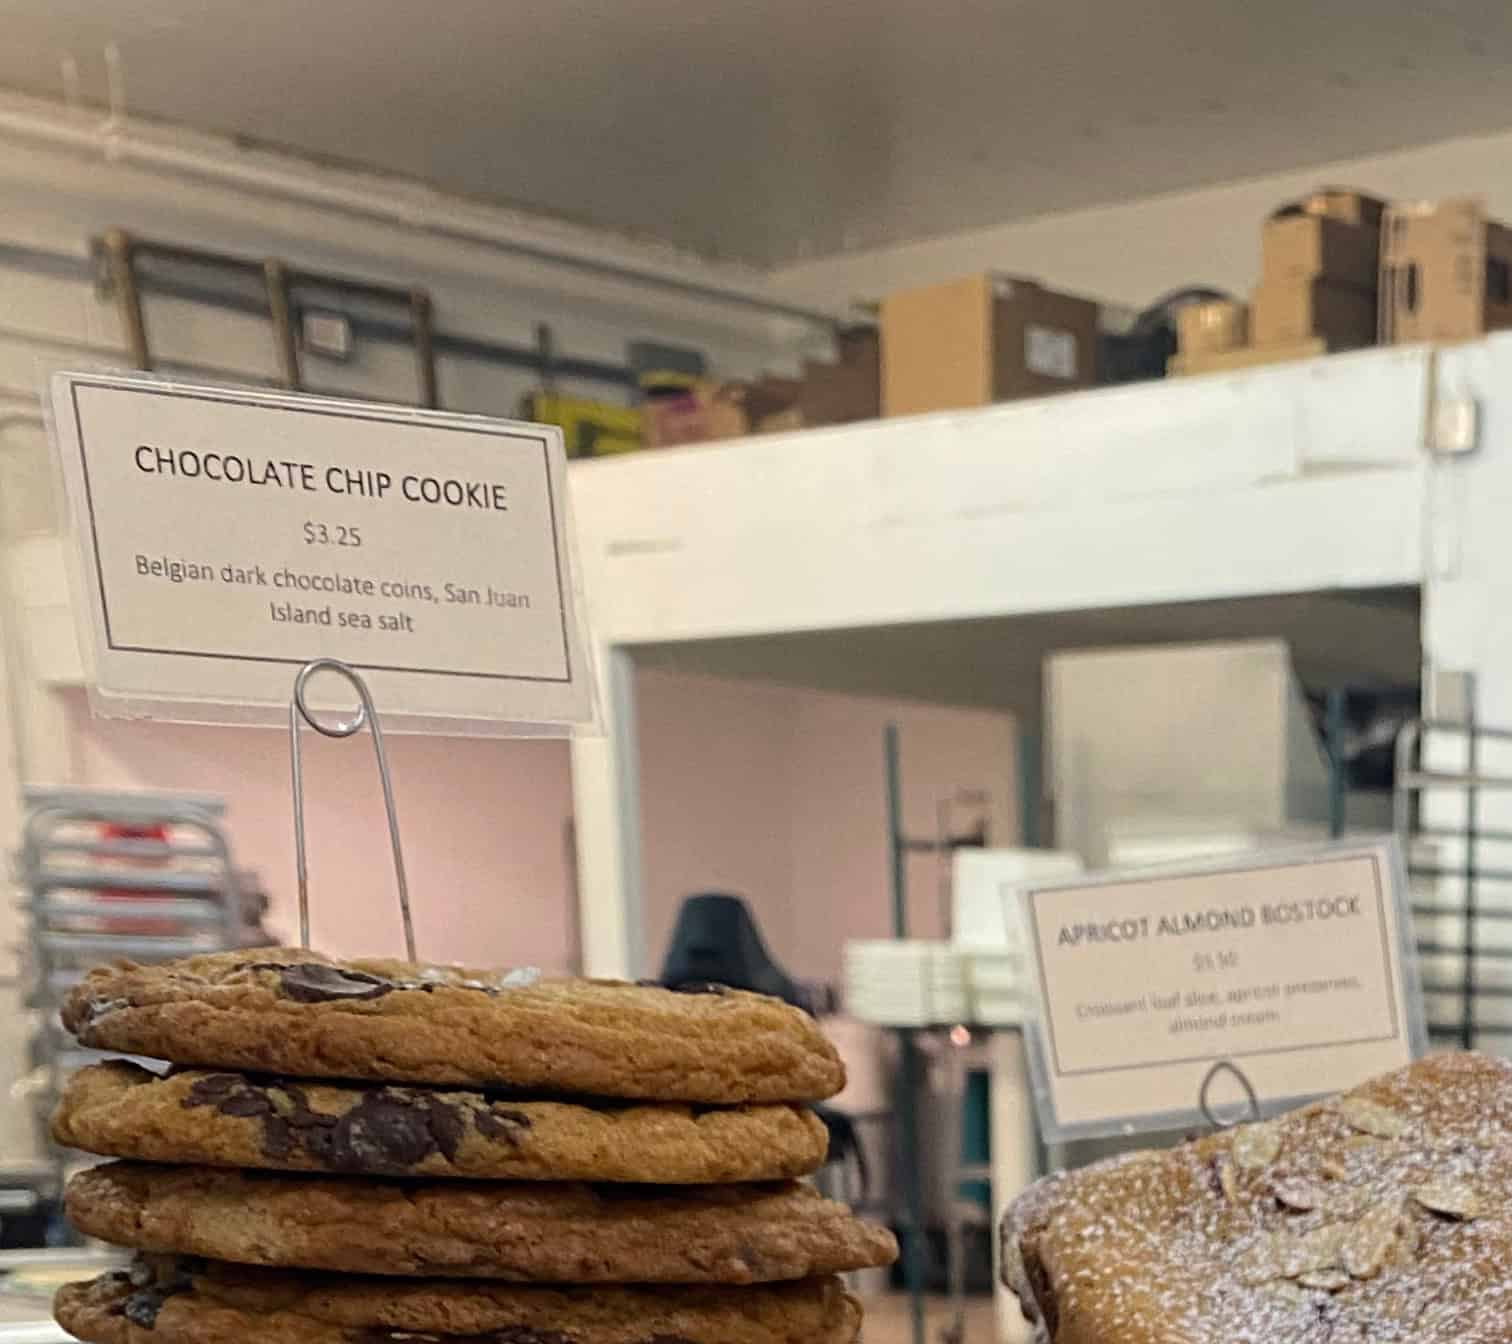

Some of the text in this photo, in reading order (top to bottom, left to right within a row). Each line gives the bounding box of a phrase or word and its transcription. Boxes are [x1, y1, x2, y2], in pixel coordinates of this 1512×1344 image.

[135, 445, 508, 511] CHOCOLATE CHIP COOKIE
[303, 521, 362, 547] $3.25
[136, 554, 531, 609] Belgian dark chocolate coins, San Juan
[270, 602, 415, 633] Island sea salt
[1057, 895, 1361, 947] APRICOT ALMOND BOSTOCK
